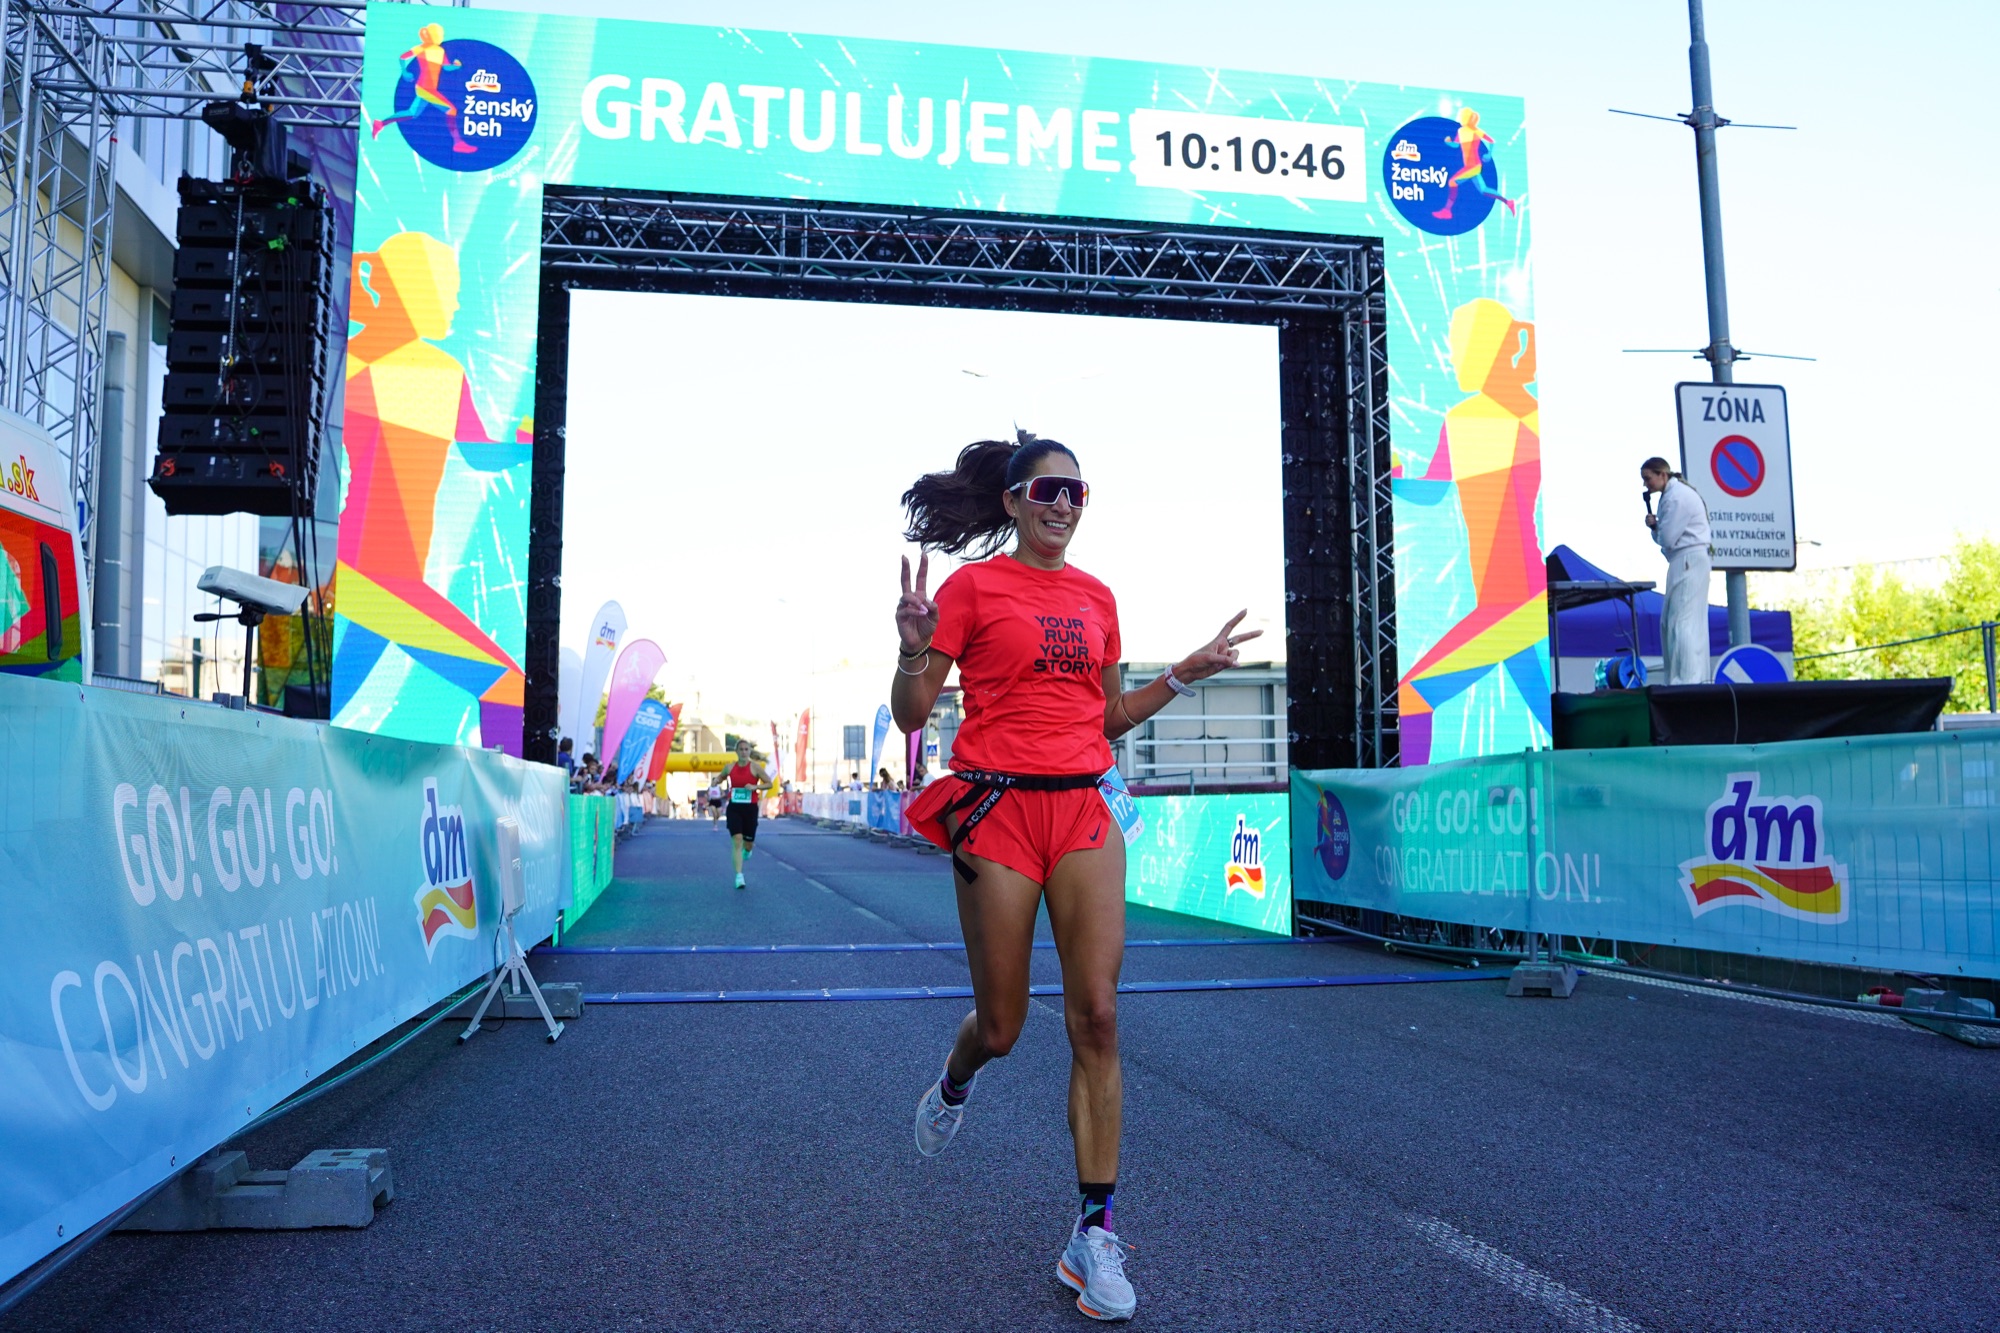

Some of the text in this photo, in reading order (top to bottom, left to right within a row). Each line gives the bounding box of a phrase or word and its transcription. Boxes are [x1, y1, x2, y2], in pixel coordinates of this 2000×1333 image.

[473, 71, 496, 84] dm
[463, 94, 533, 122] ženský
[463, 117, 501, 137] beh
[1155, 130, 1345, 180] 10:10:46
[1391, 162, 1449, 188] ženský
[1392, 181, 1424, 201] beh
[1701, 390, 1766, 423] ZÓNA
[0, 454, 40, 502] .sk
[1709, 509, 1775, 523] STÁTIE POVOLENÉ
[1716, 530, 1728, 539] NA
[1729, 528, 1786, 540] VYZNAČENÝCH
[1753, 548, 1791, 558] MIESTACH
[600, 621, 616, 640] dm
[1034, 615, 1086, 630] YOUR
[1044, 629, 1088, 645] RUN,
[1039, 644, 1089, 660] YOUR
[1033, 658, 1095, 675] STORY
[1392, 790, 1429, 834] GO!
[1435, 790, 1479, 834] GO!
[1488, 787, 1539, 835] GO!
[1711, 781, 1817, 863] dm
[113, 782, 339, 907] GO! GO! GO!
[424, 787, 468, 886] dm
[1233, 819, 1259, 865] dm
[1333, 843, 1344, 856] beh
[1375, 845, 1601, 904] CONGRATULATION!
[51, 896, 385, 1112] CONGRATULATION!
